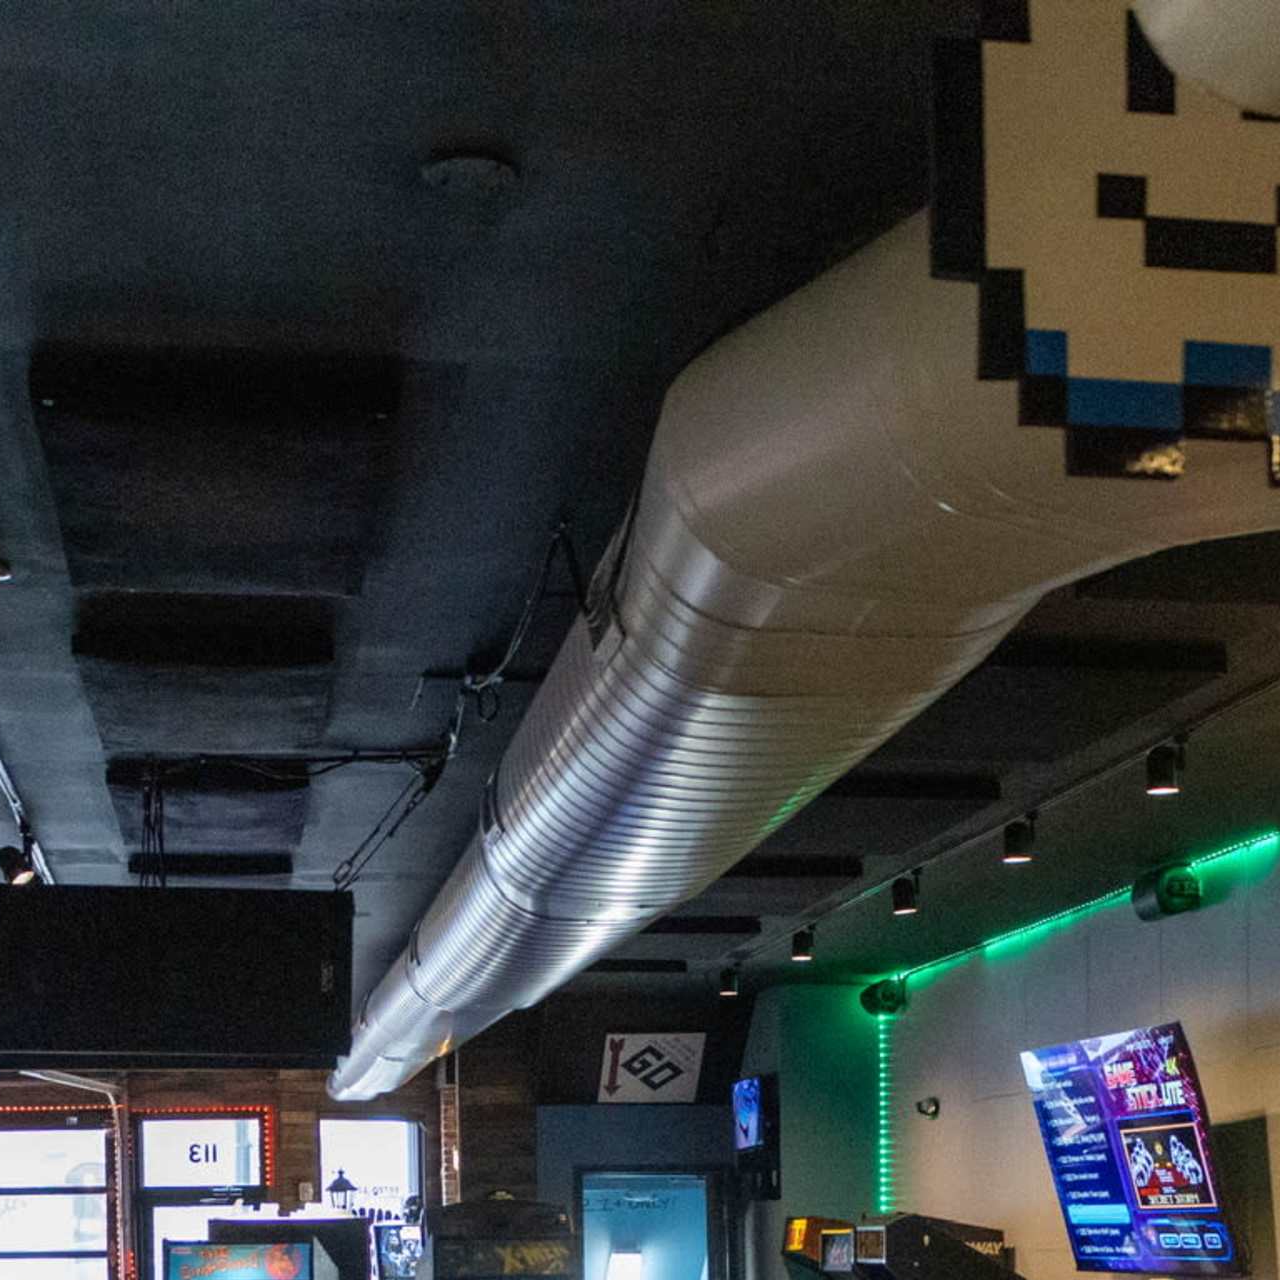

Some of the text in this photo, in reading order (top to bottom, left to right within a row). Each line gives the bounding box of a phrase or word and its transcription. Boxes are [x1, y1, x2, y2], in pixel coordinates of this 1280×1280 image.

[621, 1045, 684, 1091] GO
[1103, 1061, 1138, 1090] GAME
[1161, 1080, 1186, 1107] LITE
